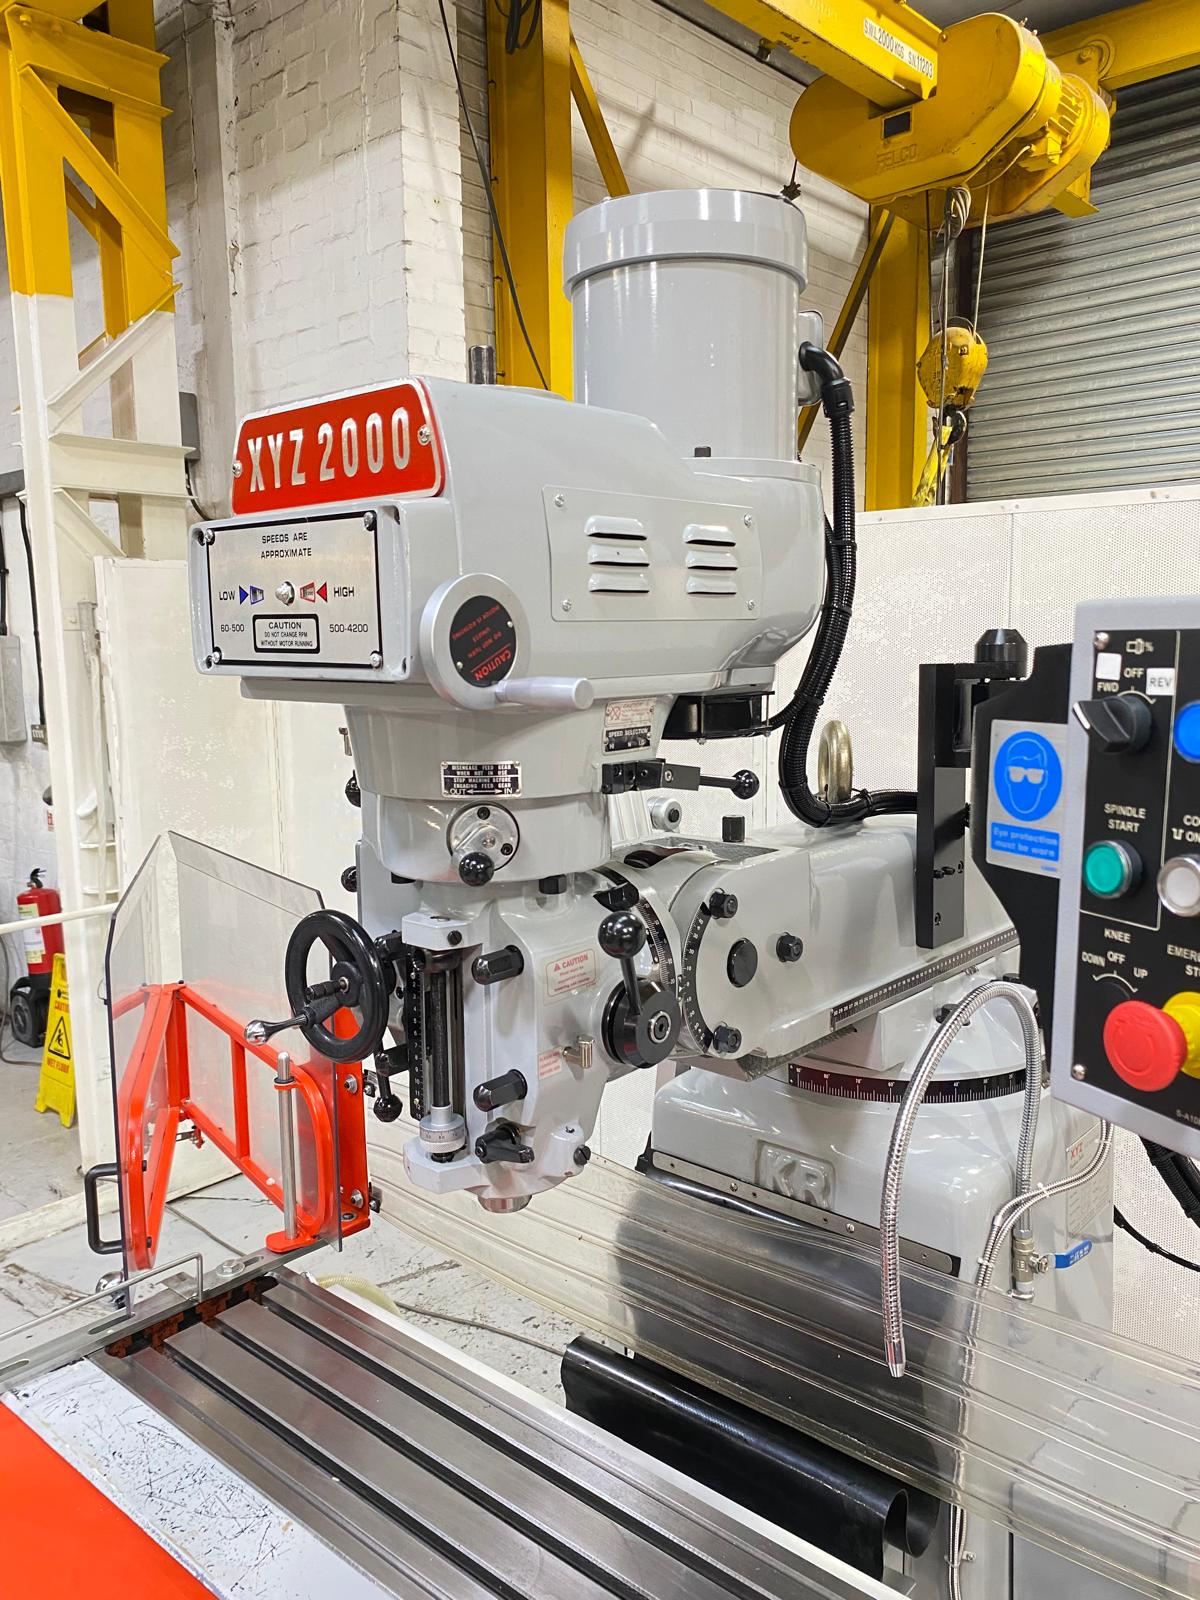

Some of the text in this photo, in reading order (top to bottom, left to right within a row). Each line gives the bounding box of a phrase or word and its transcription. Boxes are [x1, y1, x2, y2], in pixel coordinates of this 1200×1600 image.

[247, 406, 411, 493] XYZ 2000
[261, 532, 308, 544] SPEEDS ARE
[260, 548, 312, 559] APPROXIMATE
[218, 591, 236, 601] LOW
[333, 586, 355, 598] HIGH
[220, 623, 245, 633] 60-500
[268, 621, 302, 630] CAUTION
[329, 623, 369, 633] 500-4200
[474, 649, 512, 681] CAUTION
[1123, 667, 1144, 678] OFF
[1096, 682, 1119, 692] FWD
[1150, 677, 1172, 688] REV
[1104, 803, 1146, 819] SPINDLE
[1107, 818, 1140, 833] START
[993, 827, 1008, 838] Eye
[1017, 843, 1029, 852] be
[1104, 928, 1131, 944] KNEE
[562, 953, 589, 969] CAUTION
[1081, 951, 1106, 967] DOWN
[1106, 950, 1125, 964] OFF
[1133, 967, 1148, 978] UP
[761, 1146, 830, 1209] KR
